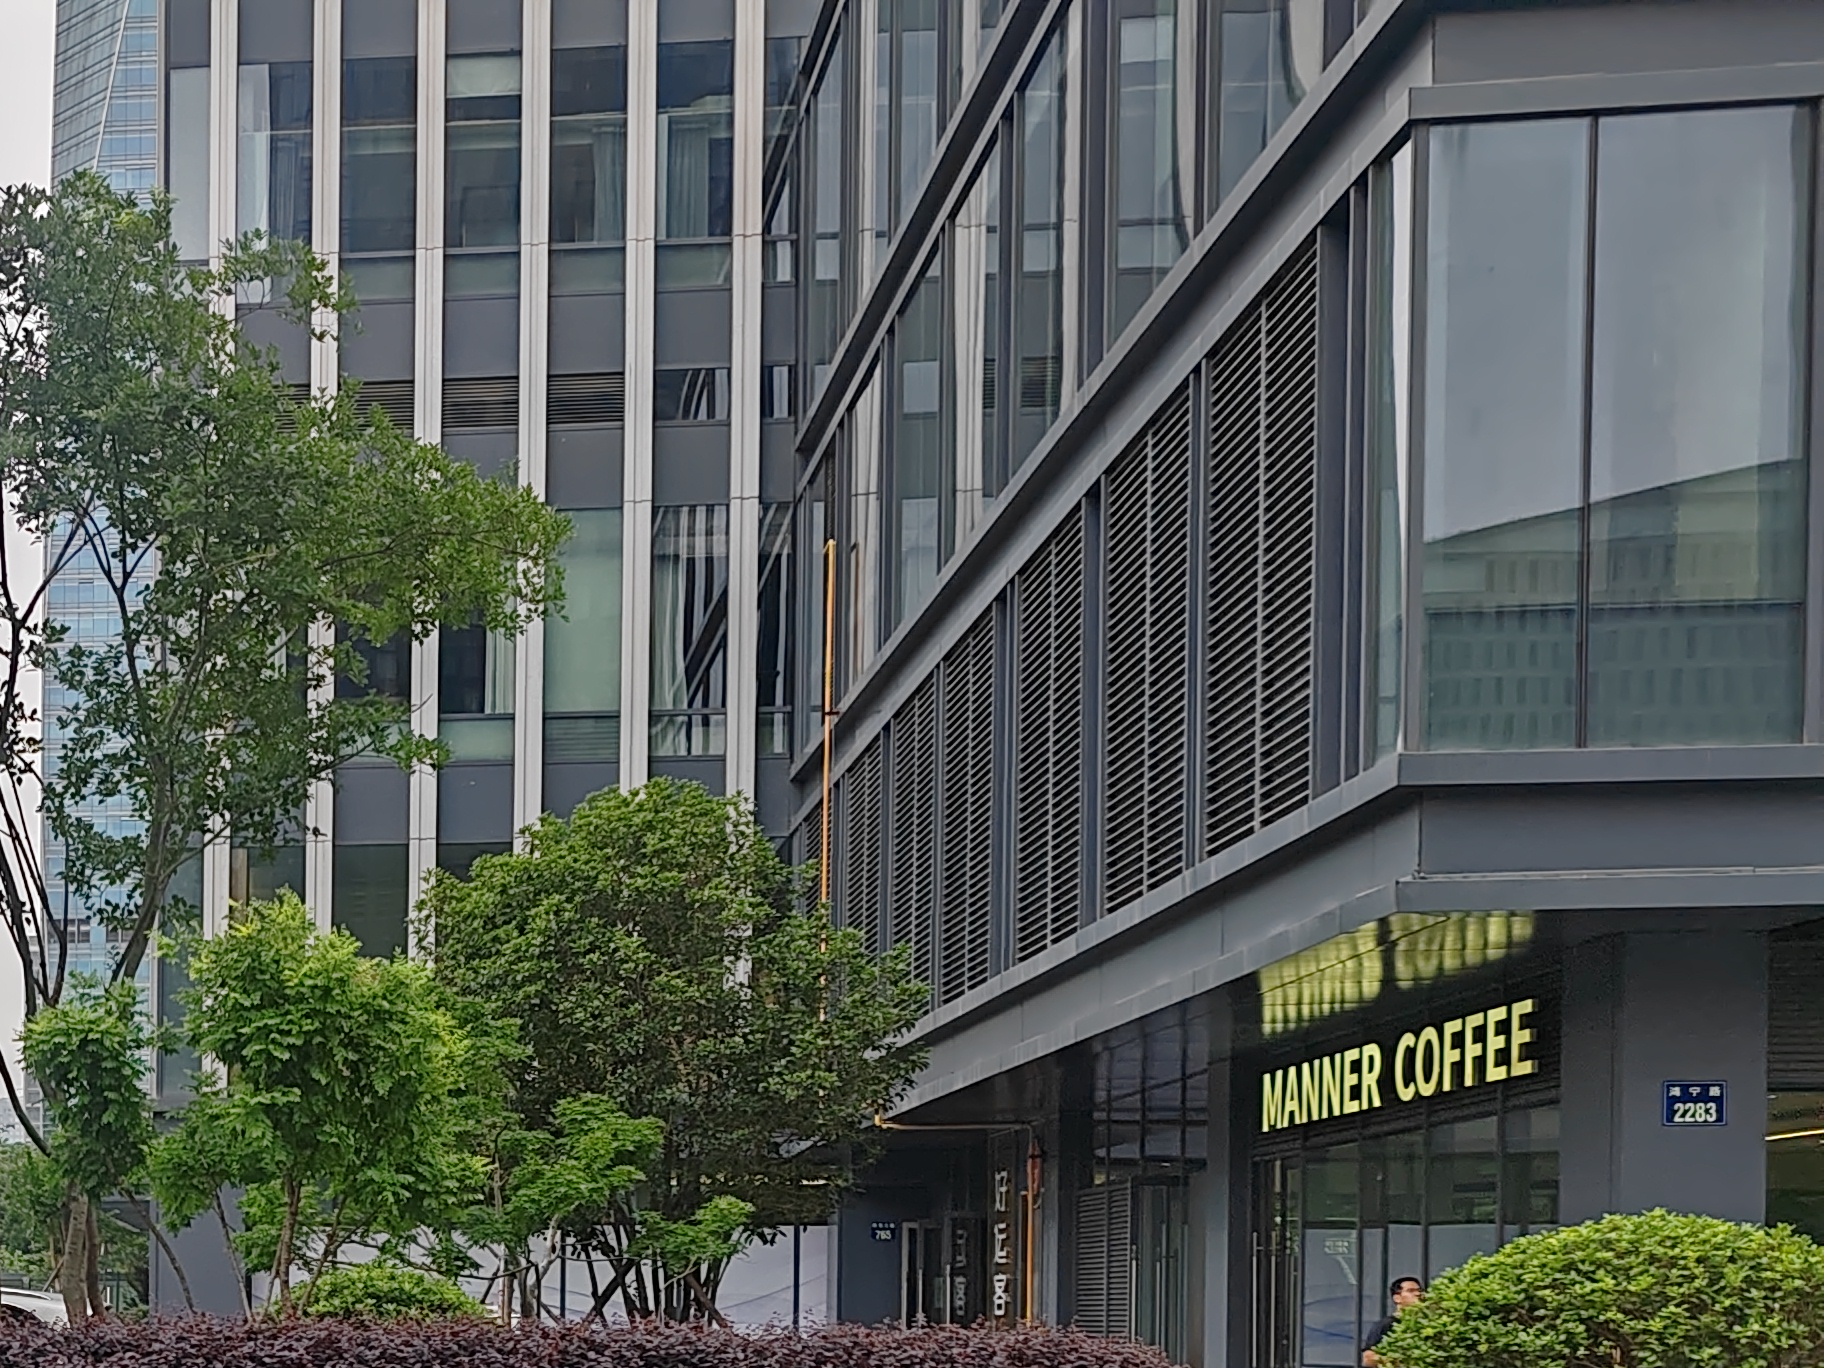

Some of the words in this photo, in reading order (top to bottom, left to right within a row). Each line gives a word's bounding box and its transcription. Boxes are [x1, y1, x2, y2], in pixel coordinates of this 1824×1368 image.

[1261, 1043, 1383, 1133] MANNER
[1394, 998, 1539, 1103] COFFEE
[1673, 1102, 1717, 1122] 2283
